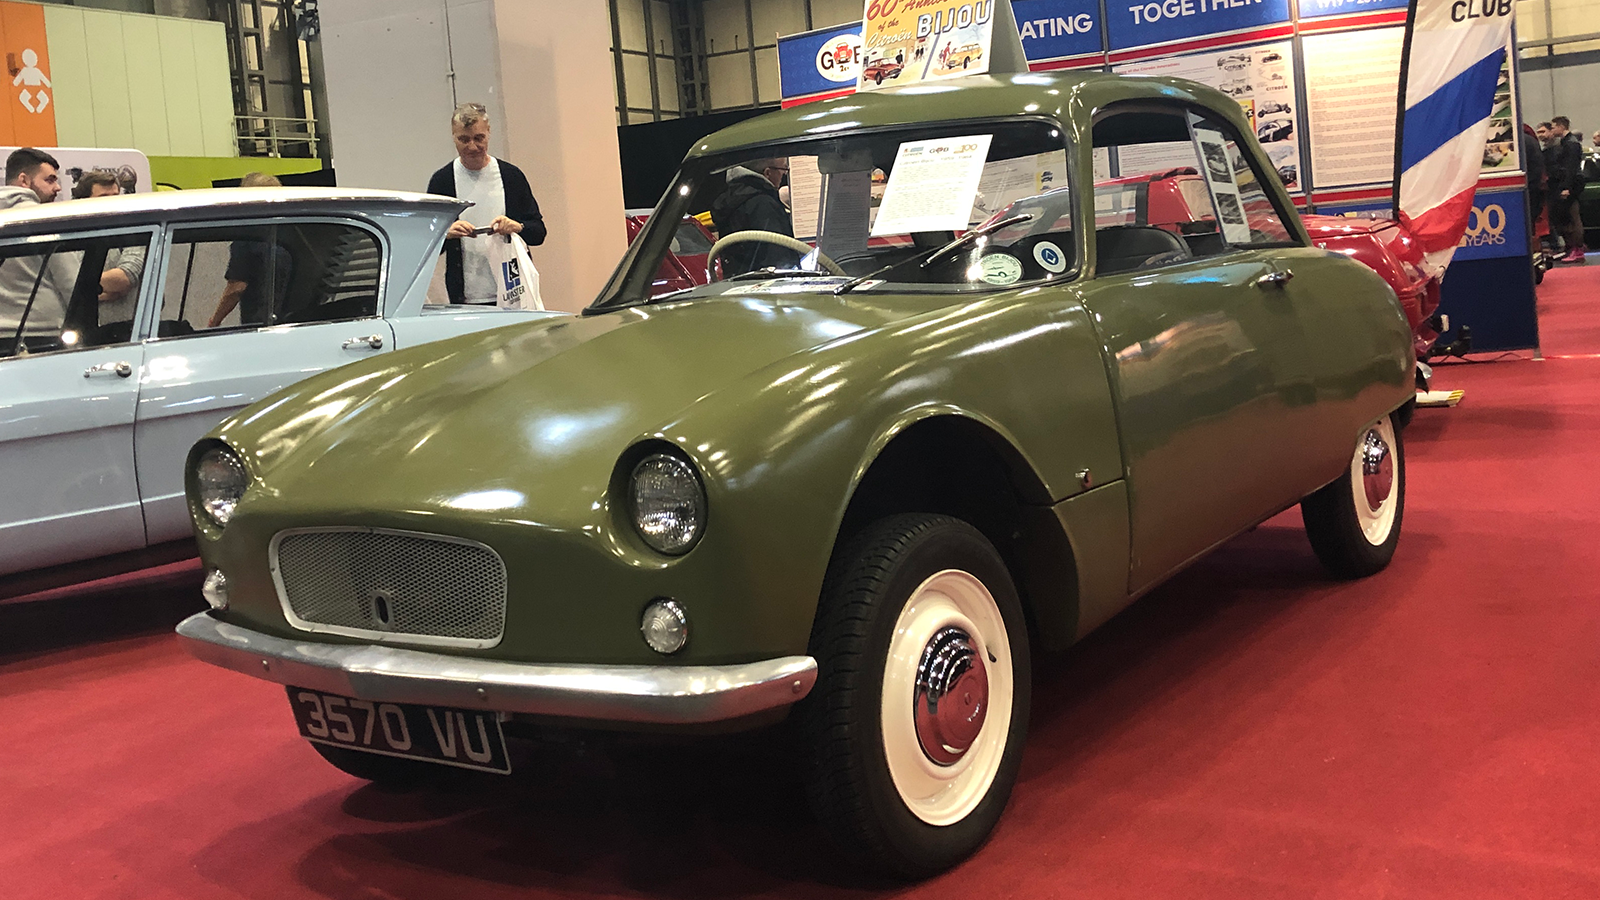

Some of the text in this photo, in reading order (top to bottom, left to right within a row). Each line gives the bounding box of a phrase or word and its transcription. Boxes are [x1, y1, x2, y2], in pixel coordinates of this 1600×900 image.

[916, 0, 991, 39] BIJOU
[1129, 0, 1263, 25] TOGETH
[1451, 0, 1512, 22] CLUB
[887, 18, 899, 28] the
[865, 29, 913, 52] Citroën
[1466, 231, 1506, 247] YEARS
[298, 691, 492, 763] 3570 VU
